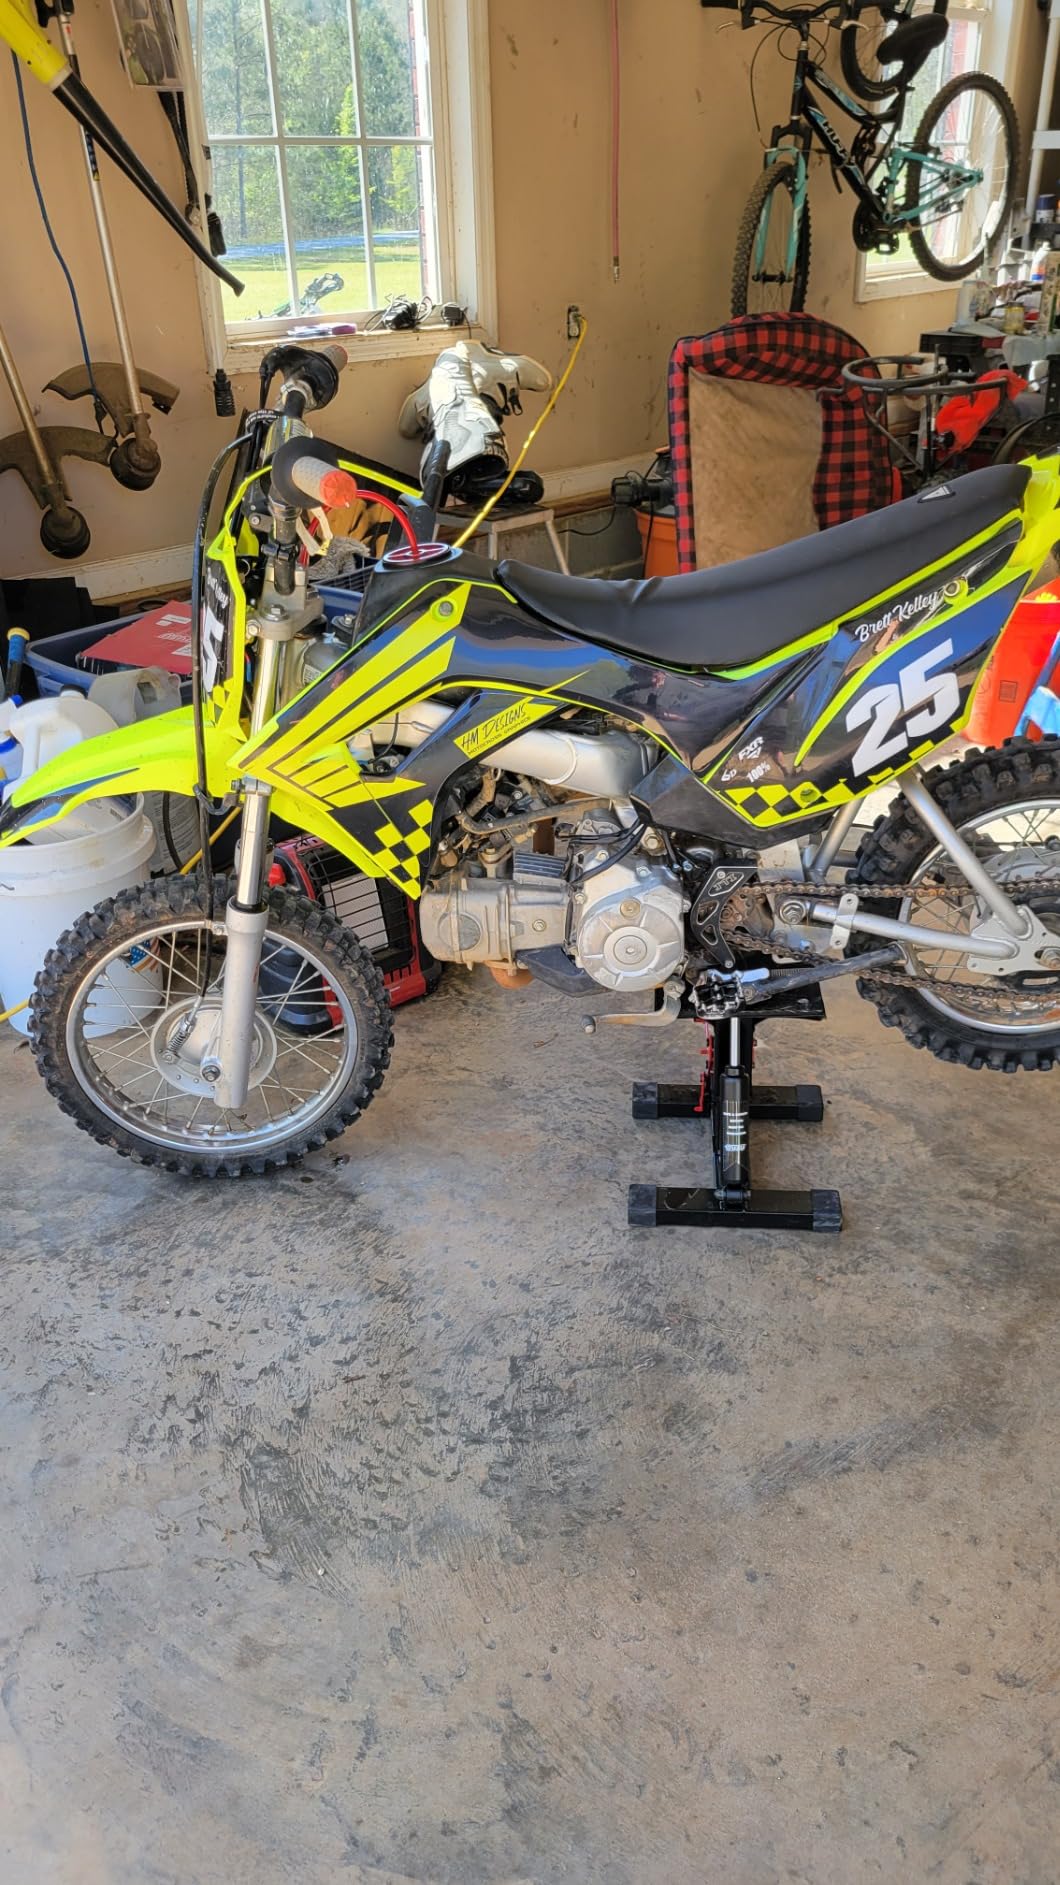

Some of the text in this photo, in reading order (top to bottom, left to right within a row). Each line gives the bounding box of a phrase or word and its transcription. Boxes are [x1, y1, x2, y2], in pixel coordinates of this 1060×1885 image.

[854, 591, 939, 643] Brett Kelley
[461, 702, 527, 751] HM DESIGNS
[845, 637, 961, 778] 25
[738, 736, 765, 761] FXR
[746, 761, 771, 783] 100%
